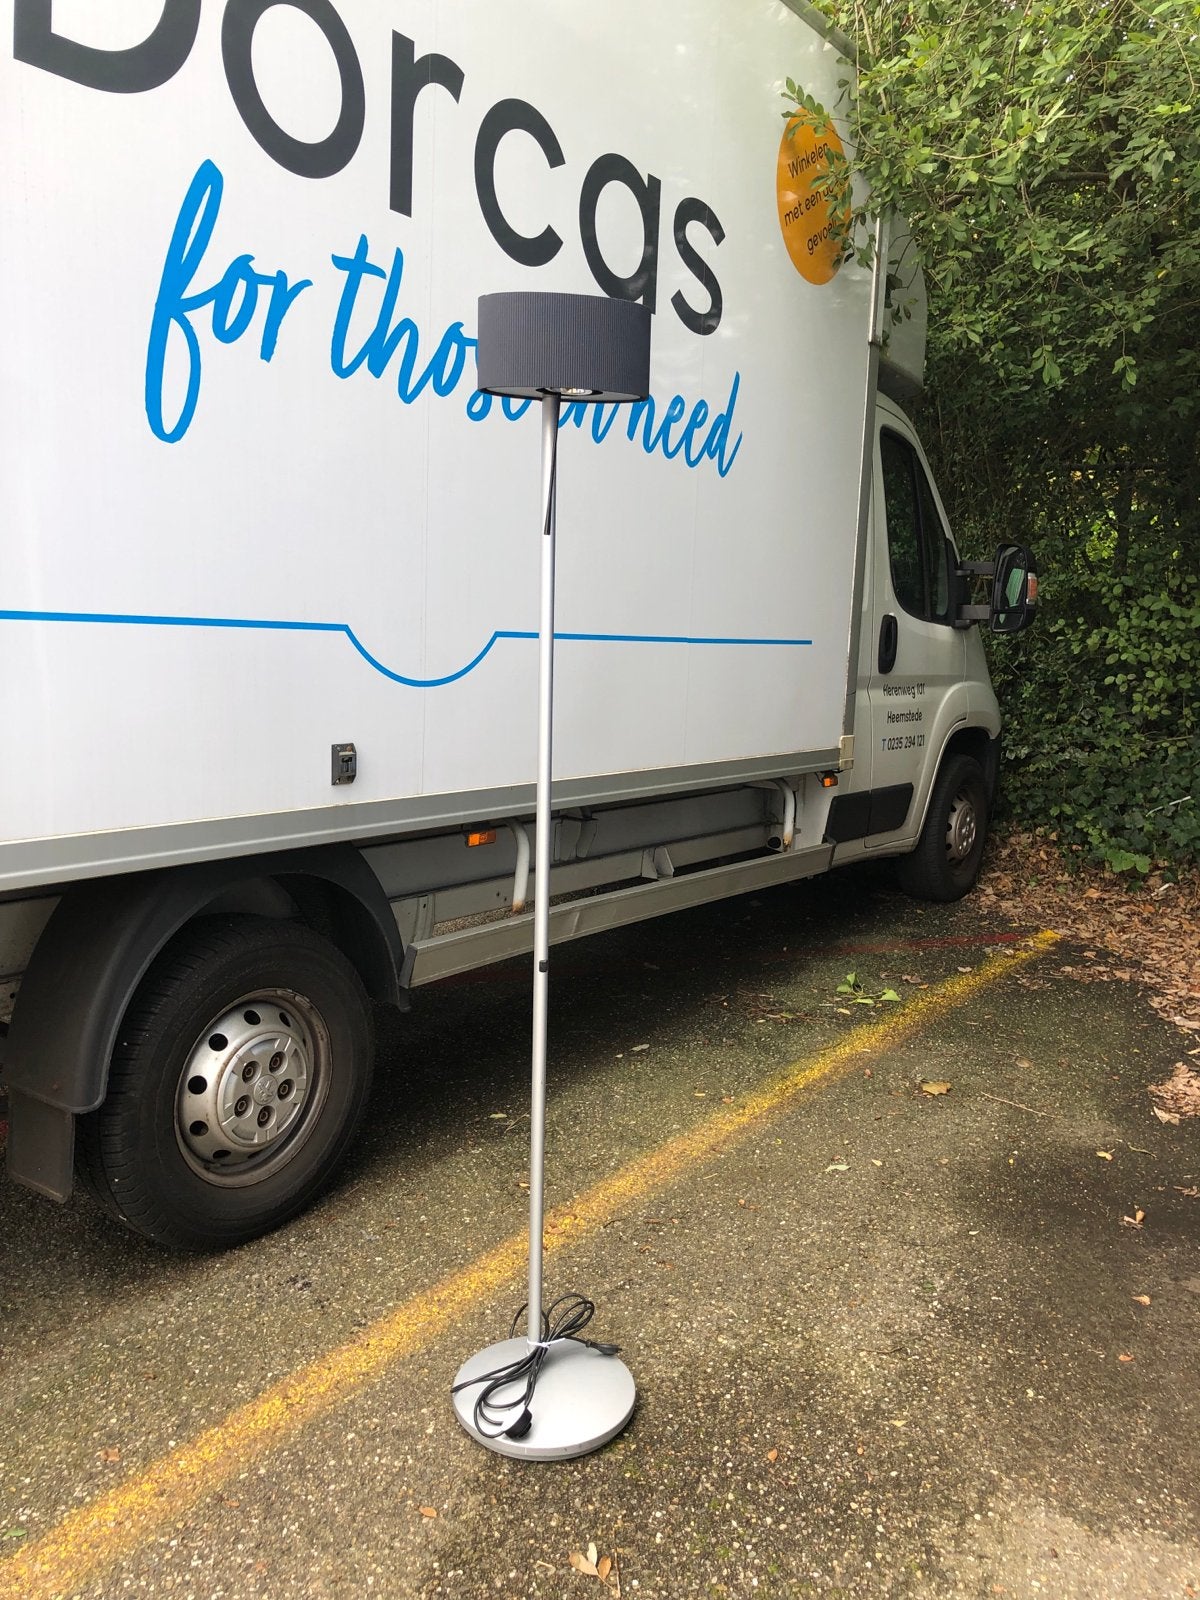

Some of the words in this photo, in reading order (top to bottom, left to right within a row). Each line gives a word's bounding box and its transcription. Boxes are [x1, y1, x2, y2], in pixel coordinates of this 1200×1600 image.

[784, 203, 803, 227] met
[805, 190, 823, 211] een
[145, 158, 312, 443] for
[626, 371, 743, 478] need
[883, 684, 916, 699] Herenweg
[917, 683, 925, 696] 101
[887, 708, 923, 723] Heemstede
[882, 739, 886, 751] T
[887, 737, 903, 750] 0235
[904, 735, 916, 749] 294
[917, 734, 925, 747] 121
